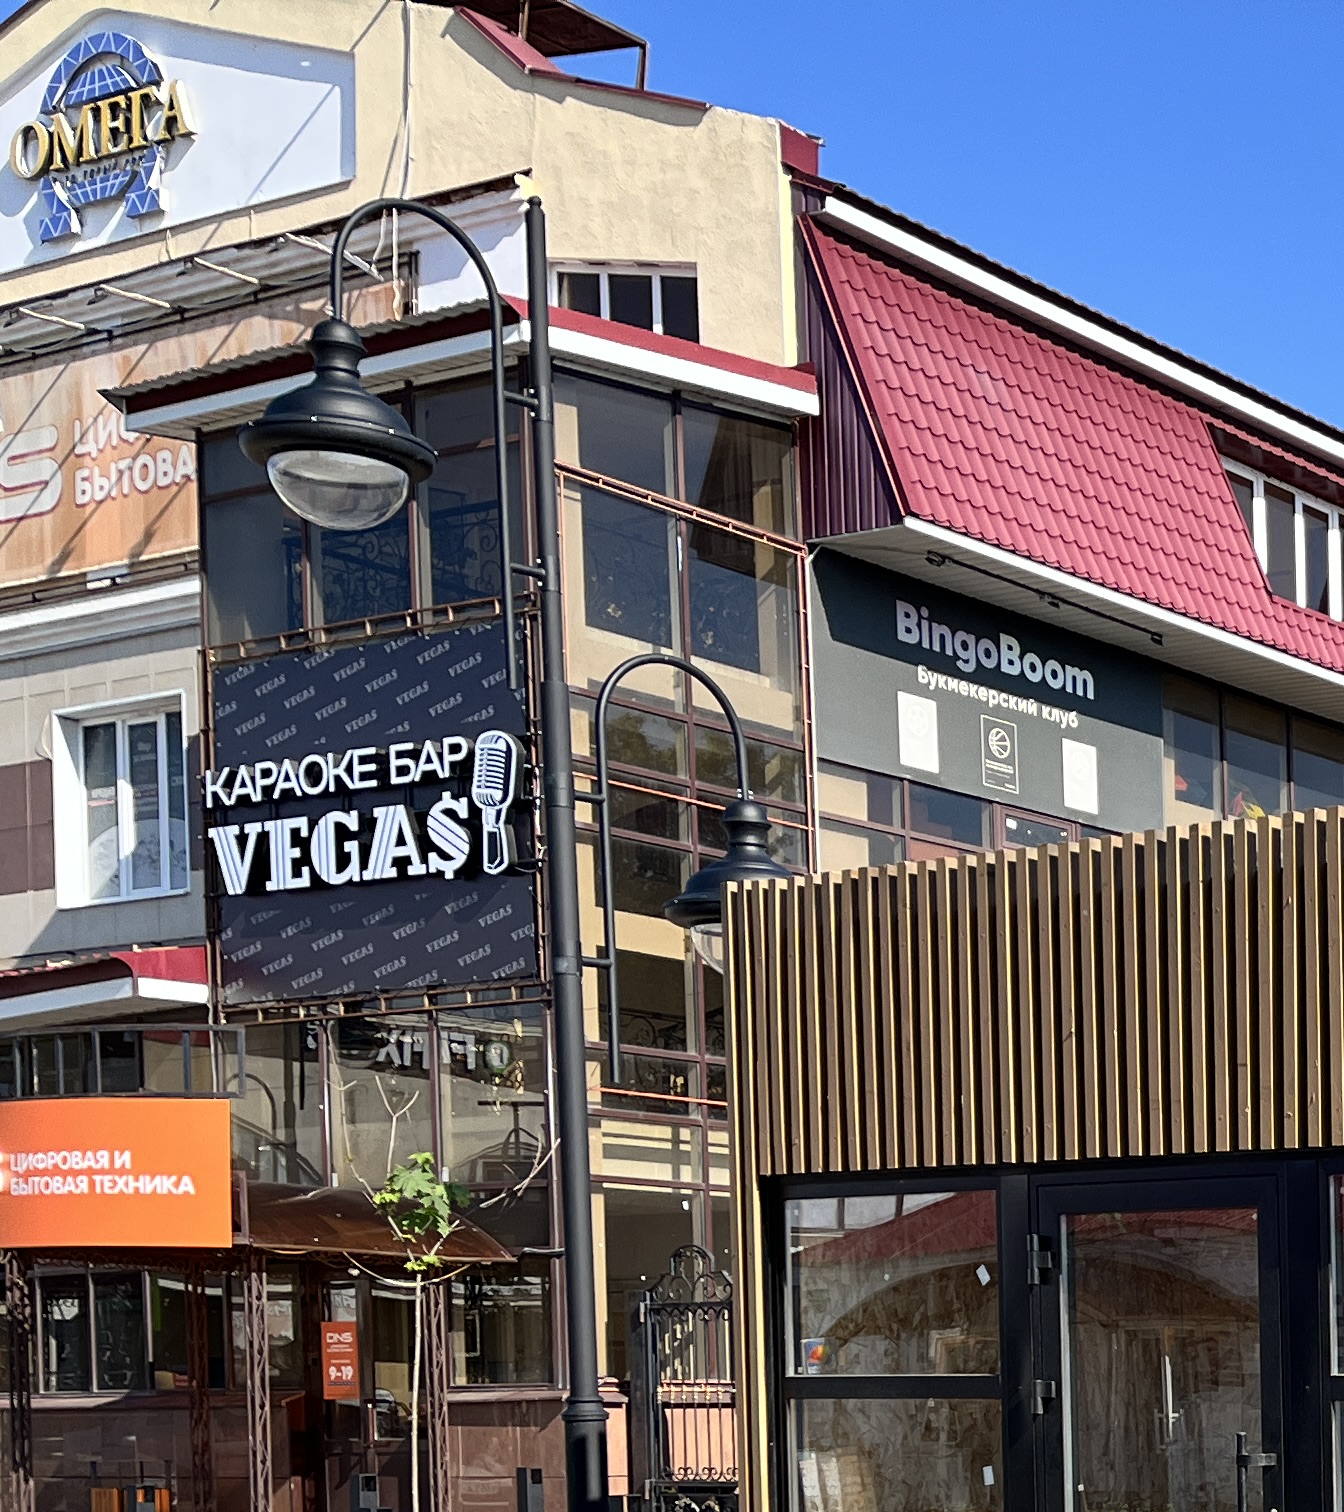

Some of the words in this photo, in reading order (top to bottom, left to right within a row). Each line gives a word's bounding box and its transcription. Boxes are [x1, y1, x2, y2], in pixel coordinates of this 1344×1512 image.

[10, 80, 197, 180] ОМЕГА
[896, 599, 1095, 700] BingoBoom
[917, 664, 1038, 717] Букмекерский
[1041, 704, 1078, 728] клуб
[205, 746, 378, 809] КАРАОКЕ
[389, 735, 468, 785] БАР
[10, 1150, 109, 1174] ЦИФРОВАЯ
[114, 1150, 131, 1169] И
[10, 1175, 88, 1196] БЫТОВАЯ
[92, 1174, 196, 1195] ТЕХНИКА
[326, 1332, 353, 1343] DNS
[328, 1366, 353, 1381] 9-19
